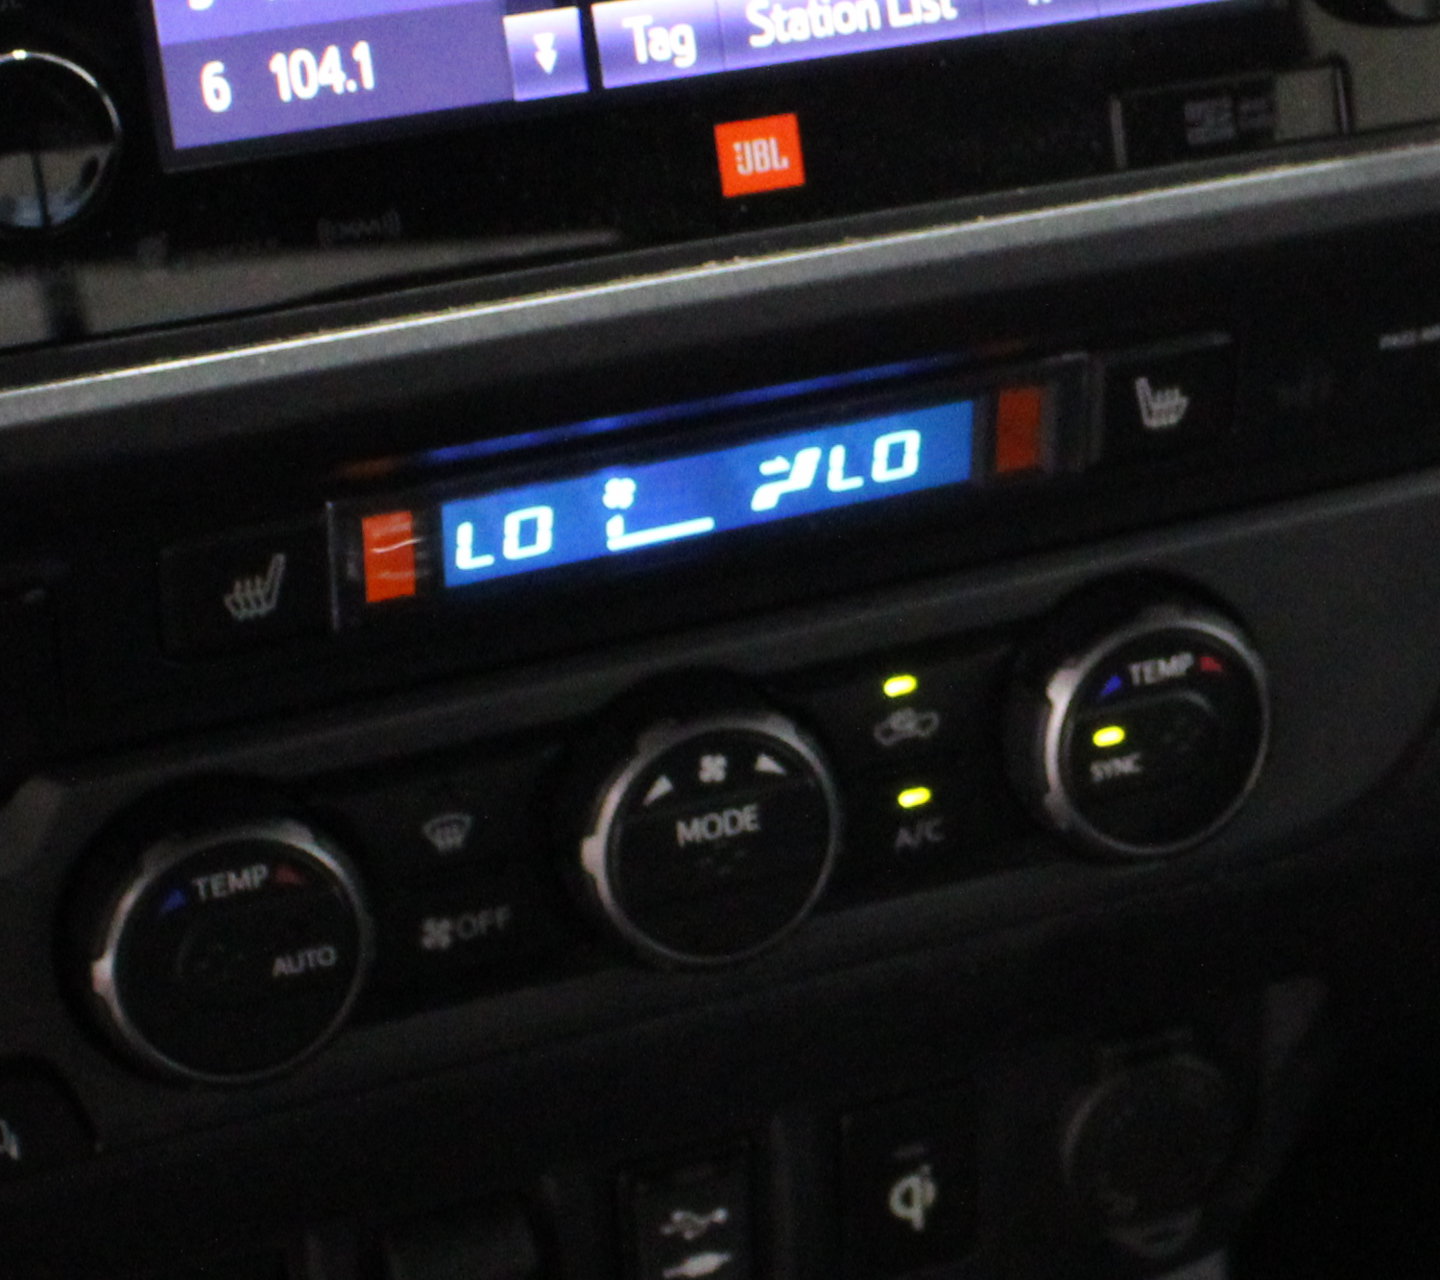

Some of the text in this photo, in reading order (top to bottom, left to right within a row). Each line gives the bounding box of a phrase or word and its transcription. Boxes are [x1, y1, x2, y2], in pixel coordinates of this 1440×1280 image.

[622, 15, 698, 70] Tag
[200, 40, 376, 114] 6 104.1
[734, 135, 790, 177] JBL
[827, 429, 922, 493] LO
[454, 506, 554, 571] LO
[1128, 652, 1197, 687] TEMP
[676, 803, 762, 848] MODE
[192, 864, 268, 903] TEMP
[457, 905, 511, 939] OFF
[271, 946, 338, 978] AUTO
